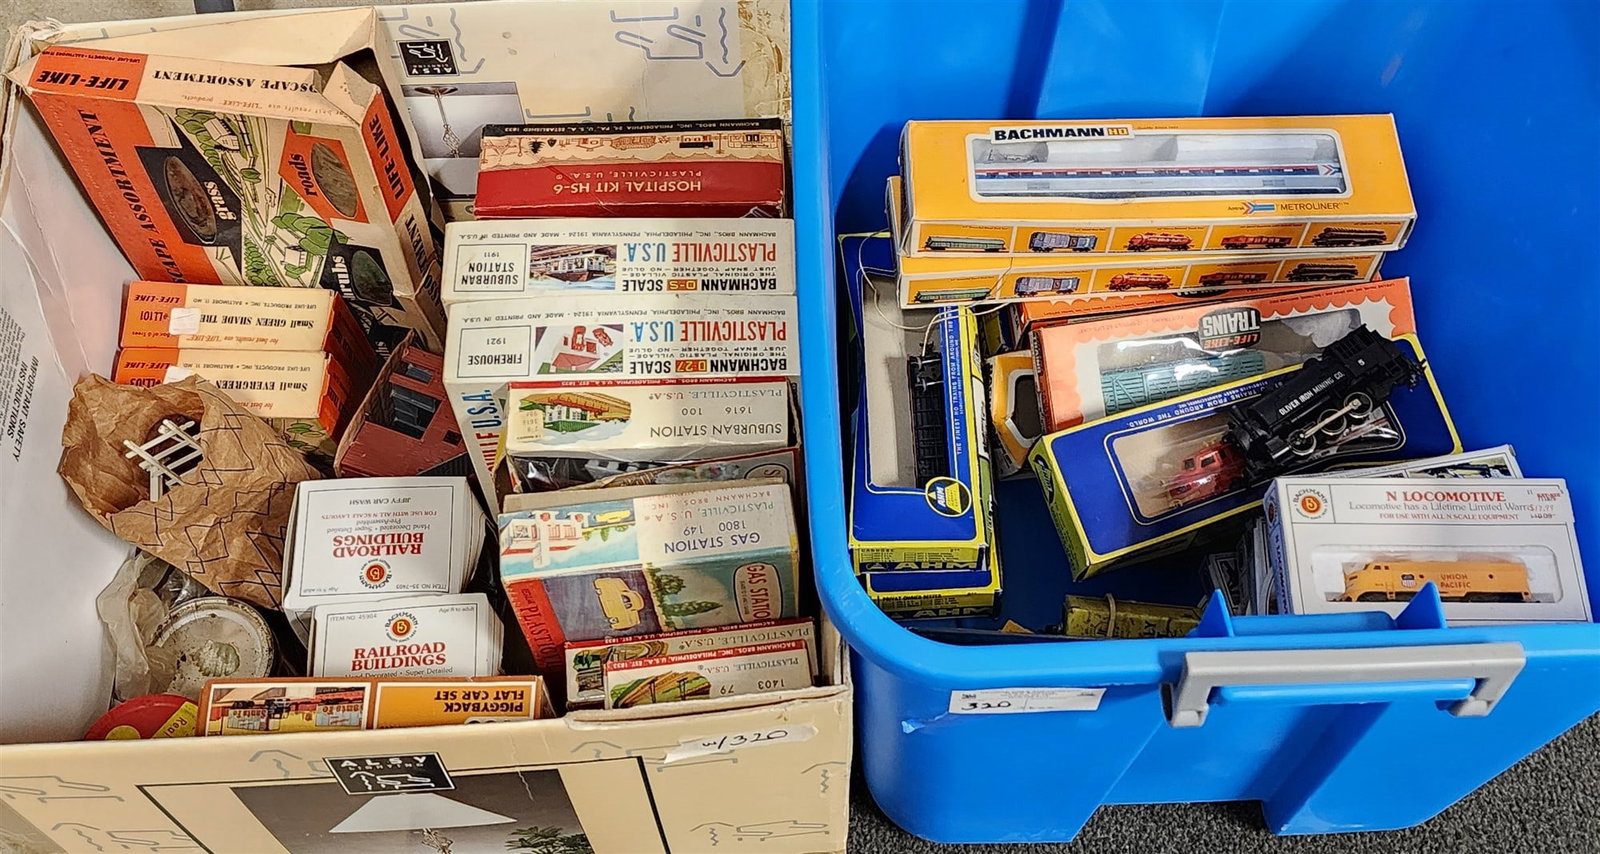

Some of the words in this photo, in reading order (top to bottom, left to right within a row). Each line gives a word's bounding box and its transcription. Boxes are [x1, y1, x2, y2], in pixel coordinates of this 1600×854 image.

[36, 71, 130, 92] LIFE-LIKE
[152, 70, 255, 88] ASSORTMENT
[993, 127, 1106, 142] BACHMANN
[368, 114, 405, 200] LIFE-LIKE
[77, 109, 160, 235] ASSORTMENT
[288, 154, 319, 197] roads
[552, 183, 590, 194] HS-6
[594, 182, 618, 193] KIT
[621, 181, 702, 192] HOSPITAL
[203, 181, 238, 221] grass
[623, 243, 666, 262] U.S.A.
[671, 243, 777, 262] PLASTICVILLE
[468, 262, 515, 273] STATION
[461, 274, 519, 285] SUBURBAN
[622, 279, 664, 292] SCALE
[700, 278, 777, 291] BACHMANN
[134, 294, 181, 304] LIFE-LIKE
[221, 314, 253, 327] SHADE
[256, 317, 287, 328] GREEN
[290, 319, 315, 329] Small
[1202, 311, 1260, 337] TRAINS
[630, 321, 674, 343] U.S.A.
[680, 321, 787, 342] PLASTICVILLE
[486, 337, 507, 345] 1921
[124, 361, 172, 370] LIFE-LIKE
[468, 354, 523, 366] FIREHOUSE
[709, 358, 787, 373] BACHMANN
[629, 361, 671, 374] SCALE
[21, 355, 40, 420] IMPORTANT
[215, 380, 276, 391] EVERGREEN
[279, 381, 308, 391] Small
[7, 360, 29, 439] INSTRUCTIONS
[1278, 399, 1301, 417] OLIVER
[1298, 389, 1314, 404] IRON
[1313, 376, 1336, 396] MINING
[1333, 371, 1346, 381] CO.
[1205, 396, 1229, 408] FROM
[681, 407, 703, 417] 100
[724, 405, 753, 416] 1616
[1173, 401, 1204, 416] AROUND
[1156, 410, 1172, 421] THE
[650, 424, 708, 438] STATION
[711, 423, 783, 435] SUBURBAN
[13, 418, 27, 463] SAFETY
[349, 498, 372, 506] WASH
[1386, 491, 1397, 502] N
[1402, 490, 1507, 502] LOCOMOTIVE
[1348, 502, 1401, 511] Locomotive
[1403, 502, 1420, 511] has
[1430, 502, 1467, 511] Lifetime
[1469, 502, 1503, 511] Limited
[1380, 512, 1395, 520] FOR
[1395, 512, 1410, 520] USE
[1410, 512, 1431, 520] WITH
[1479, 513, 1519, 521] EQUIPMENT
[683, 525, 703, 537] 149
[718, 520, 746, 532] 1800
[332, 531, 425, 547] BUILDINGS
[664, 535, 723, 554] STATION
[730, 532, 760, 546] GAS
[332, 543, 423, 559] RAILROAD
[894, 562, 978, 570] AHM
[747, 564, 767, 585] GAS
[1440, 573, 1468, 582] UNION
[358, 572, 393, 590] BACHMANN
[1439, 581, 1472, 590] PACIFIC
[749, 587, 771, 621] STATIO
[912, 607, 994, 619] AHM
[384, 611, 421, 628] BACHMANN
[353, 641, 448, 660] RAILROAD
[756, 641, 797, 651] BACHMANN
[350, 653, 447, 672] BUILDINGS
[612, 662, 628, 670] 1833
[405, 668, 426, 677] Super
[425, 666, 454, 676] Detailed
[719, 684, 735, 695] 79
[757, 679, 785, 690] 1403
[434, 690, 459, 700] SET
[460, 690, 488, 700] CAR
[494, 690, 525, 701] FLAT
[443, 701, 525, 713] PIGGYBACK
[960, 700, 1012, 711] 320
